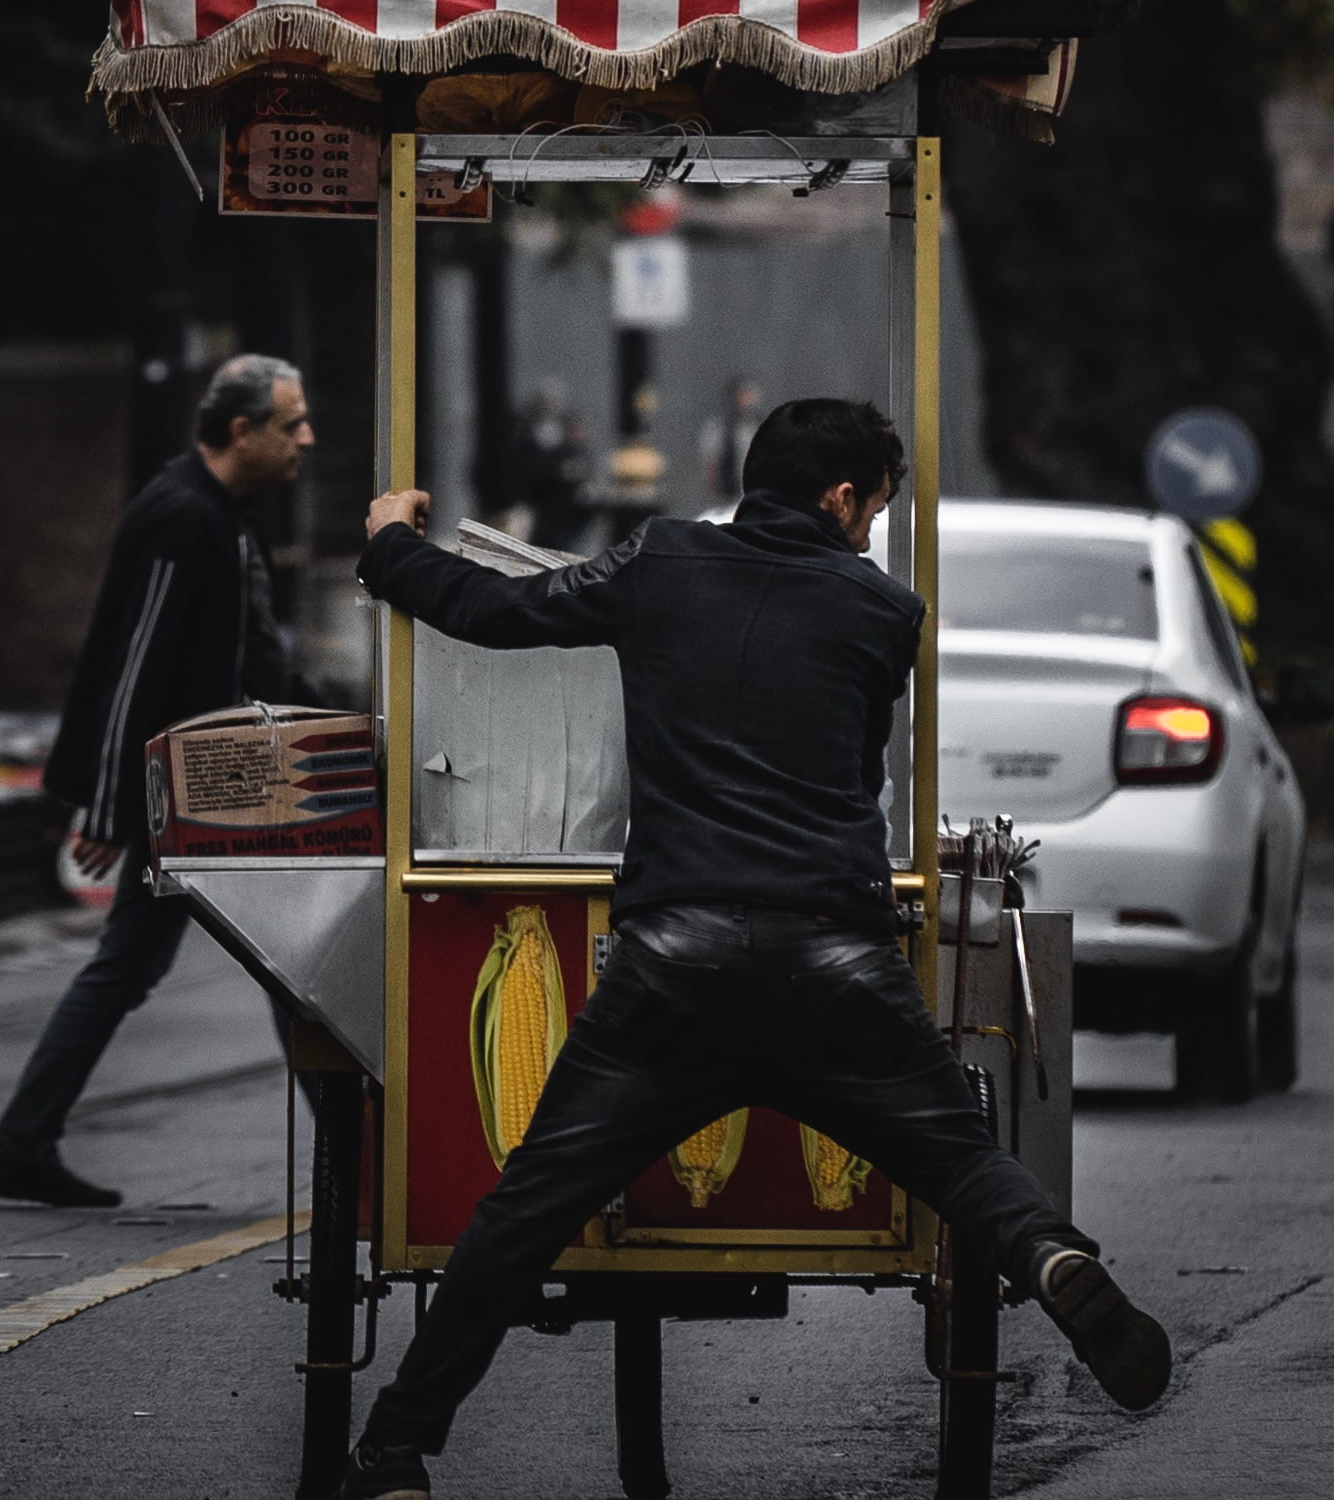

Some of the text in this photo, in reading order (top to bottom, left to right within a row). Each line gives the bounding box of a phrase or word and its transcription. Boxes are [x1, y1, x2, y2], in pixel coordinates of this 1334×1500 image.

[269, 129, 350, 144] 100 GR
[269, 147, 349, 162] 150 GR
[267, 164, 349, 179] 200 GR
[267, 181, 446, 199] 300 GR TL
[303, 824, 373, 847] KÖMÜRÜ
